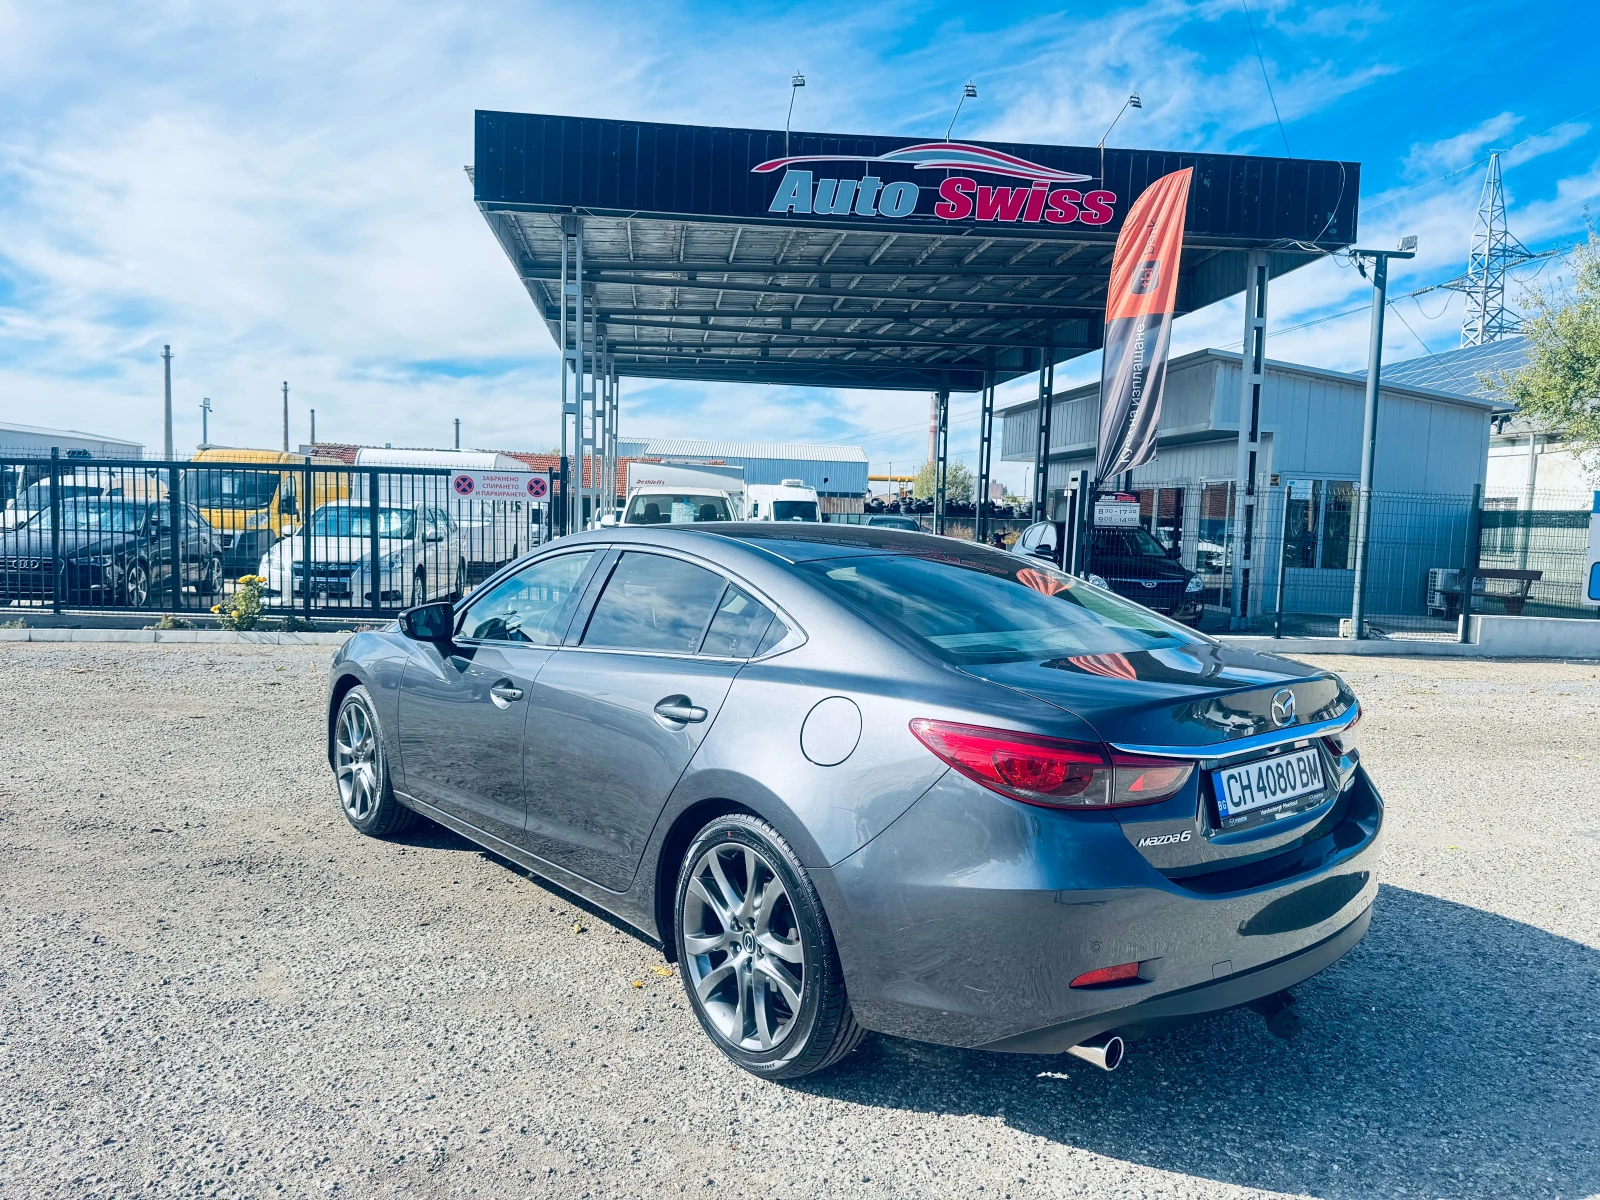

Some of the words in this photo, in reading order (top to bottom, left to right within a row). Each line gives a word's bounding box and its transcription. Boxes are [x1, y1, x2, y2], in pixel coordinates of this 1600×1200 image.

[768, 170, 920, 218] Auto
[934, 177, 1117, 225] Swiss
[1132, 323, 1146, 409] изплащане
[1129, 410, 1138, 427] на
[1218, 800, 1227, 811] BG
[1227, 770, 1255, 807] CH
[1256, 760, 1297, 799] 4080
[1296, 753, 1321, 788] BM
